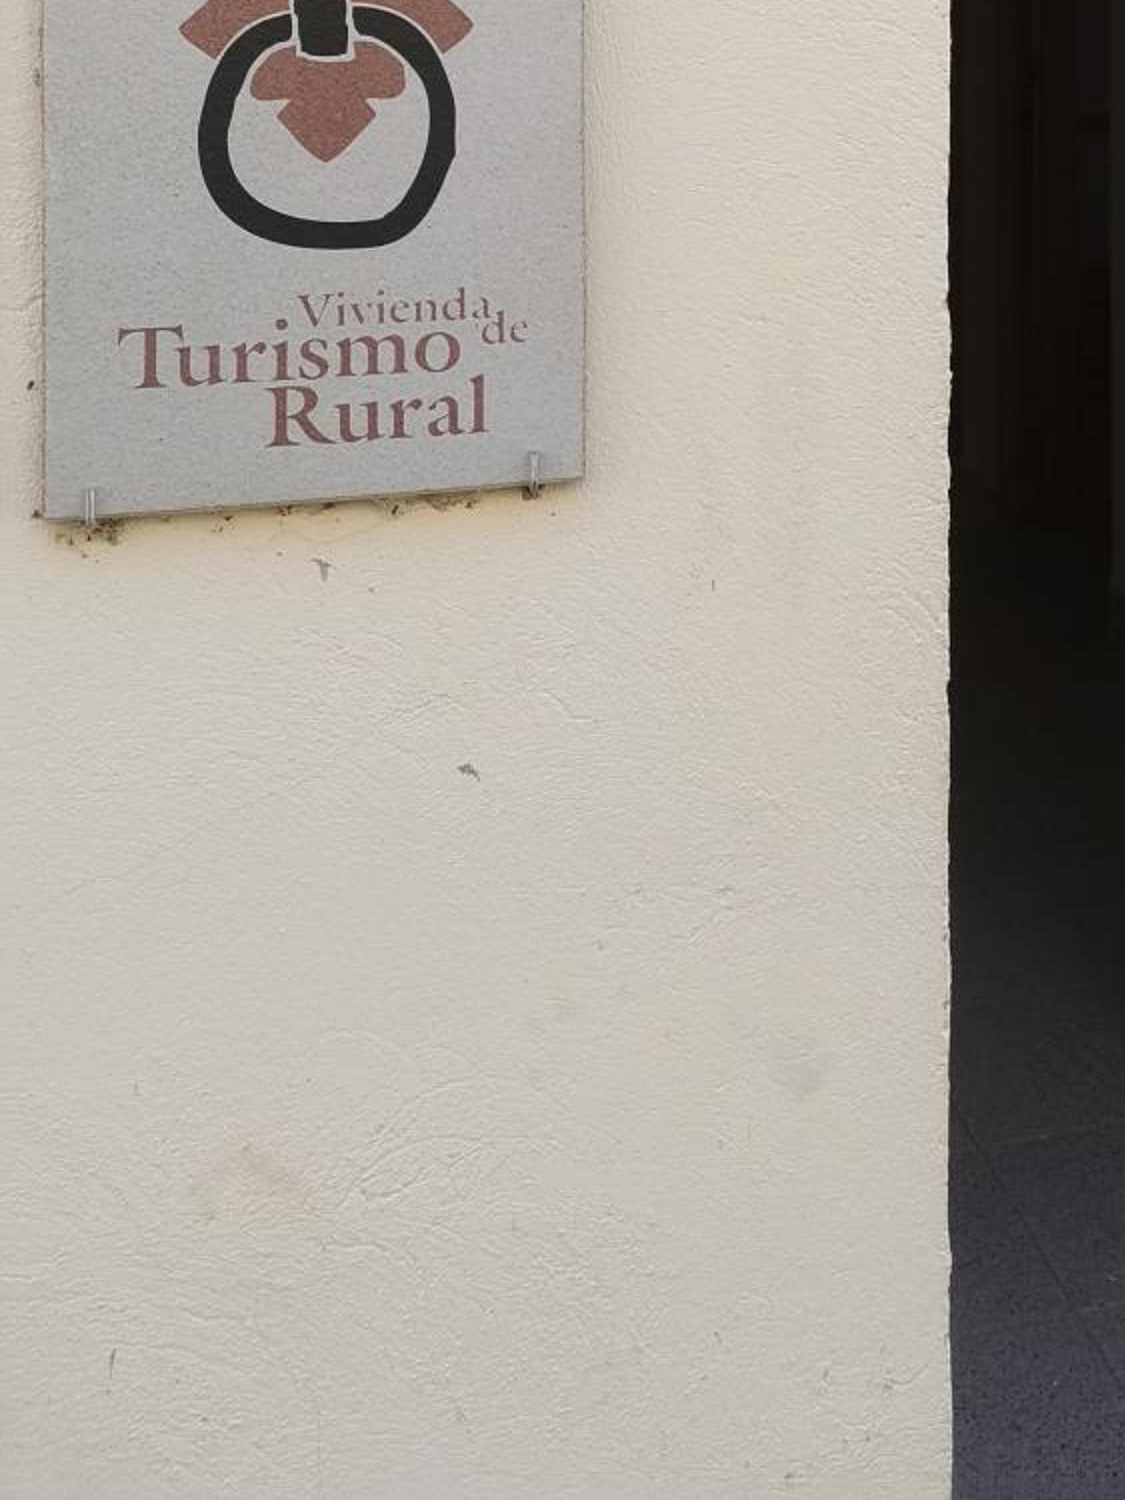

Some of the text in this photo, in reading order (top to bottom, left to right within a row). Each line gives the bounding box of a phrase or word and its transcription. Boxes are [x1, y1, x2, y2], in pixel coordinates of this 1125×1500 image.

[297, 287, 529, 345] Vivienda de
[117, 318, 460, 389] Turismo
[263, 373, 489, 448] Rural
